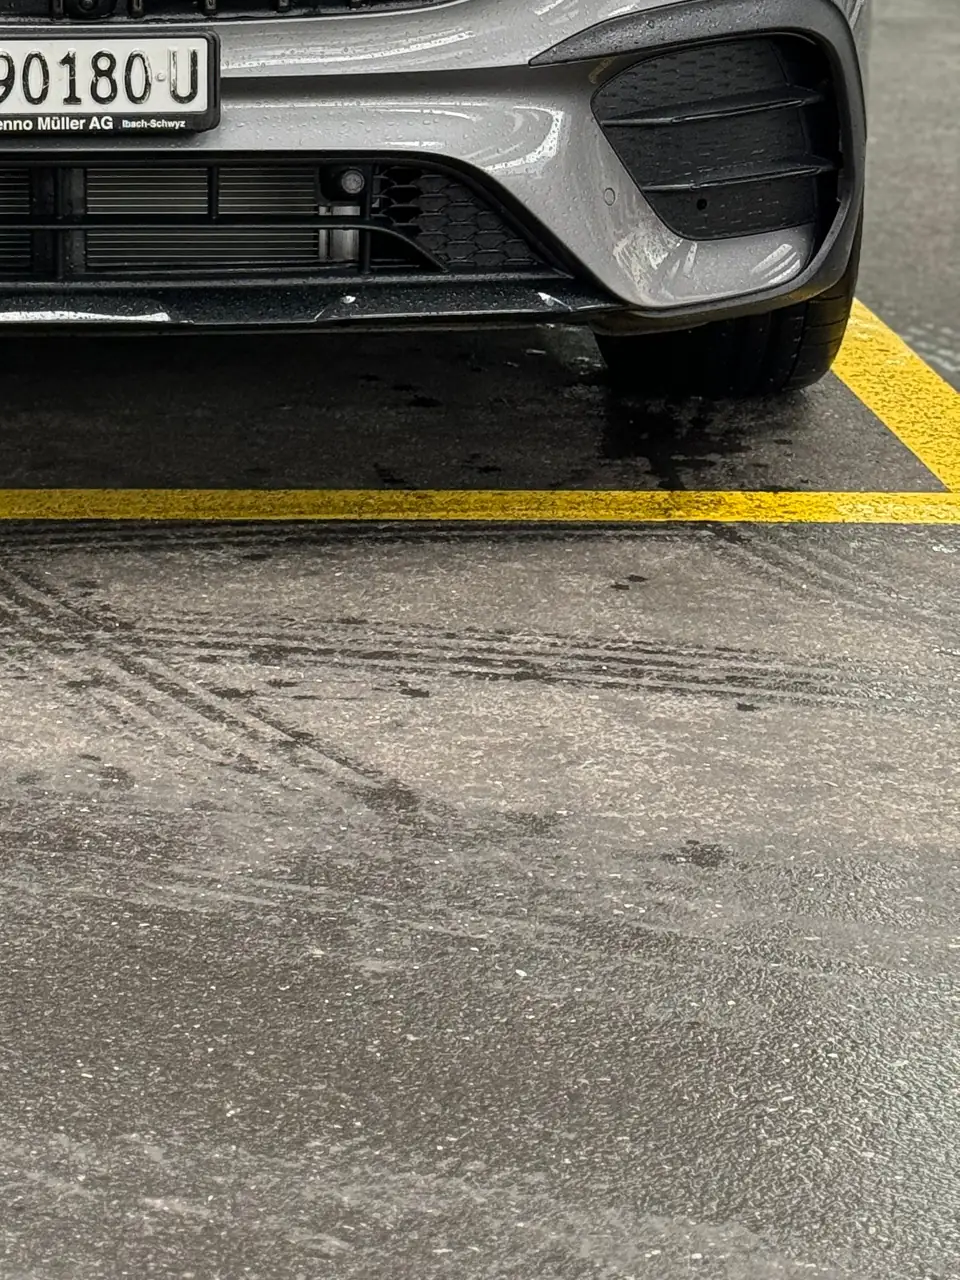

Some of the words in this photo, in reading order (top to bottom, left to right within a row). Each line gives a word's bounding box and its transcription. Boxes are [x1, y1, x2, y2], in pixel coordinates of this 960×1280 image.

[168, 48, 199, 104] U
[37, 116, 86, 130] Müller
[88, 116, 114, 130] AG
